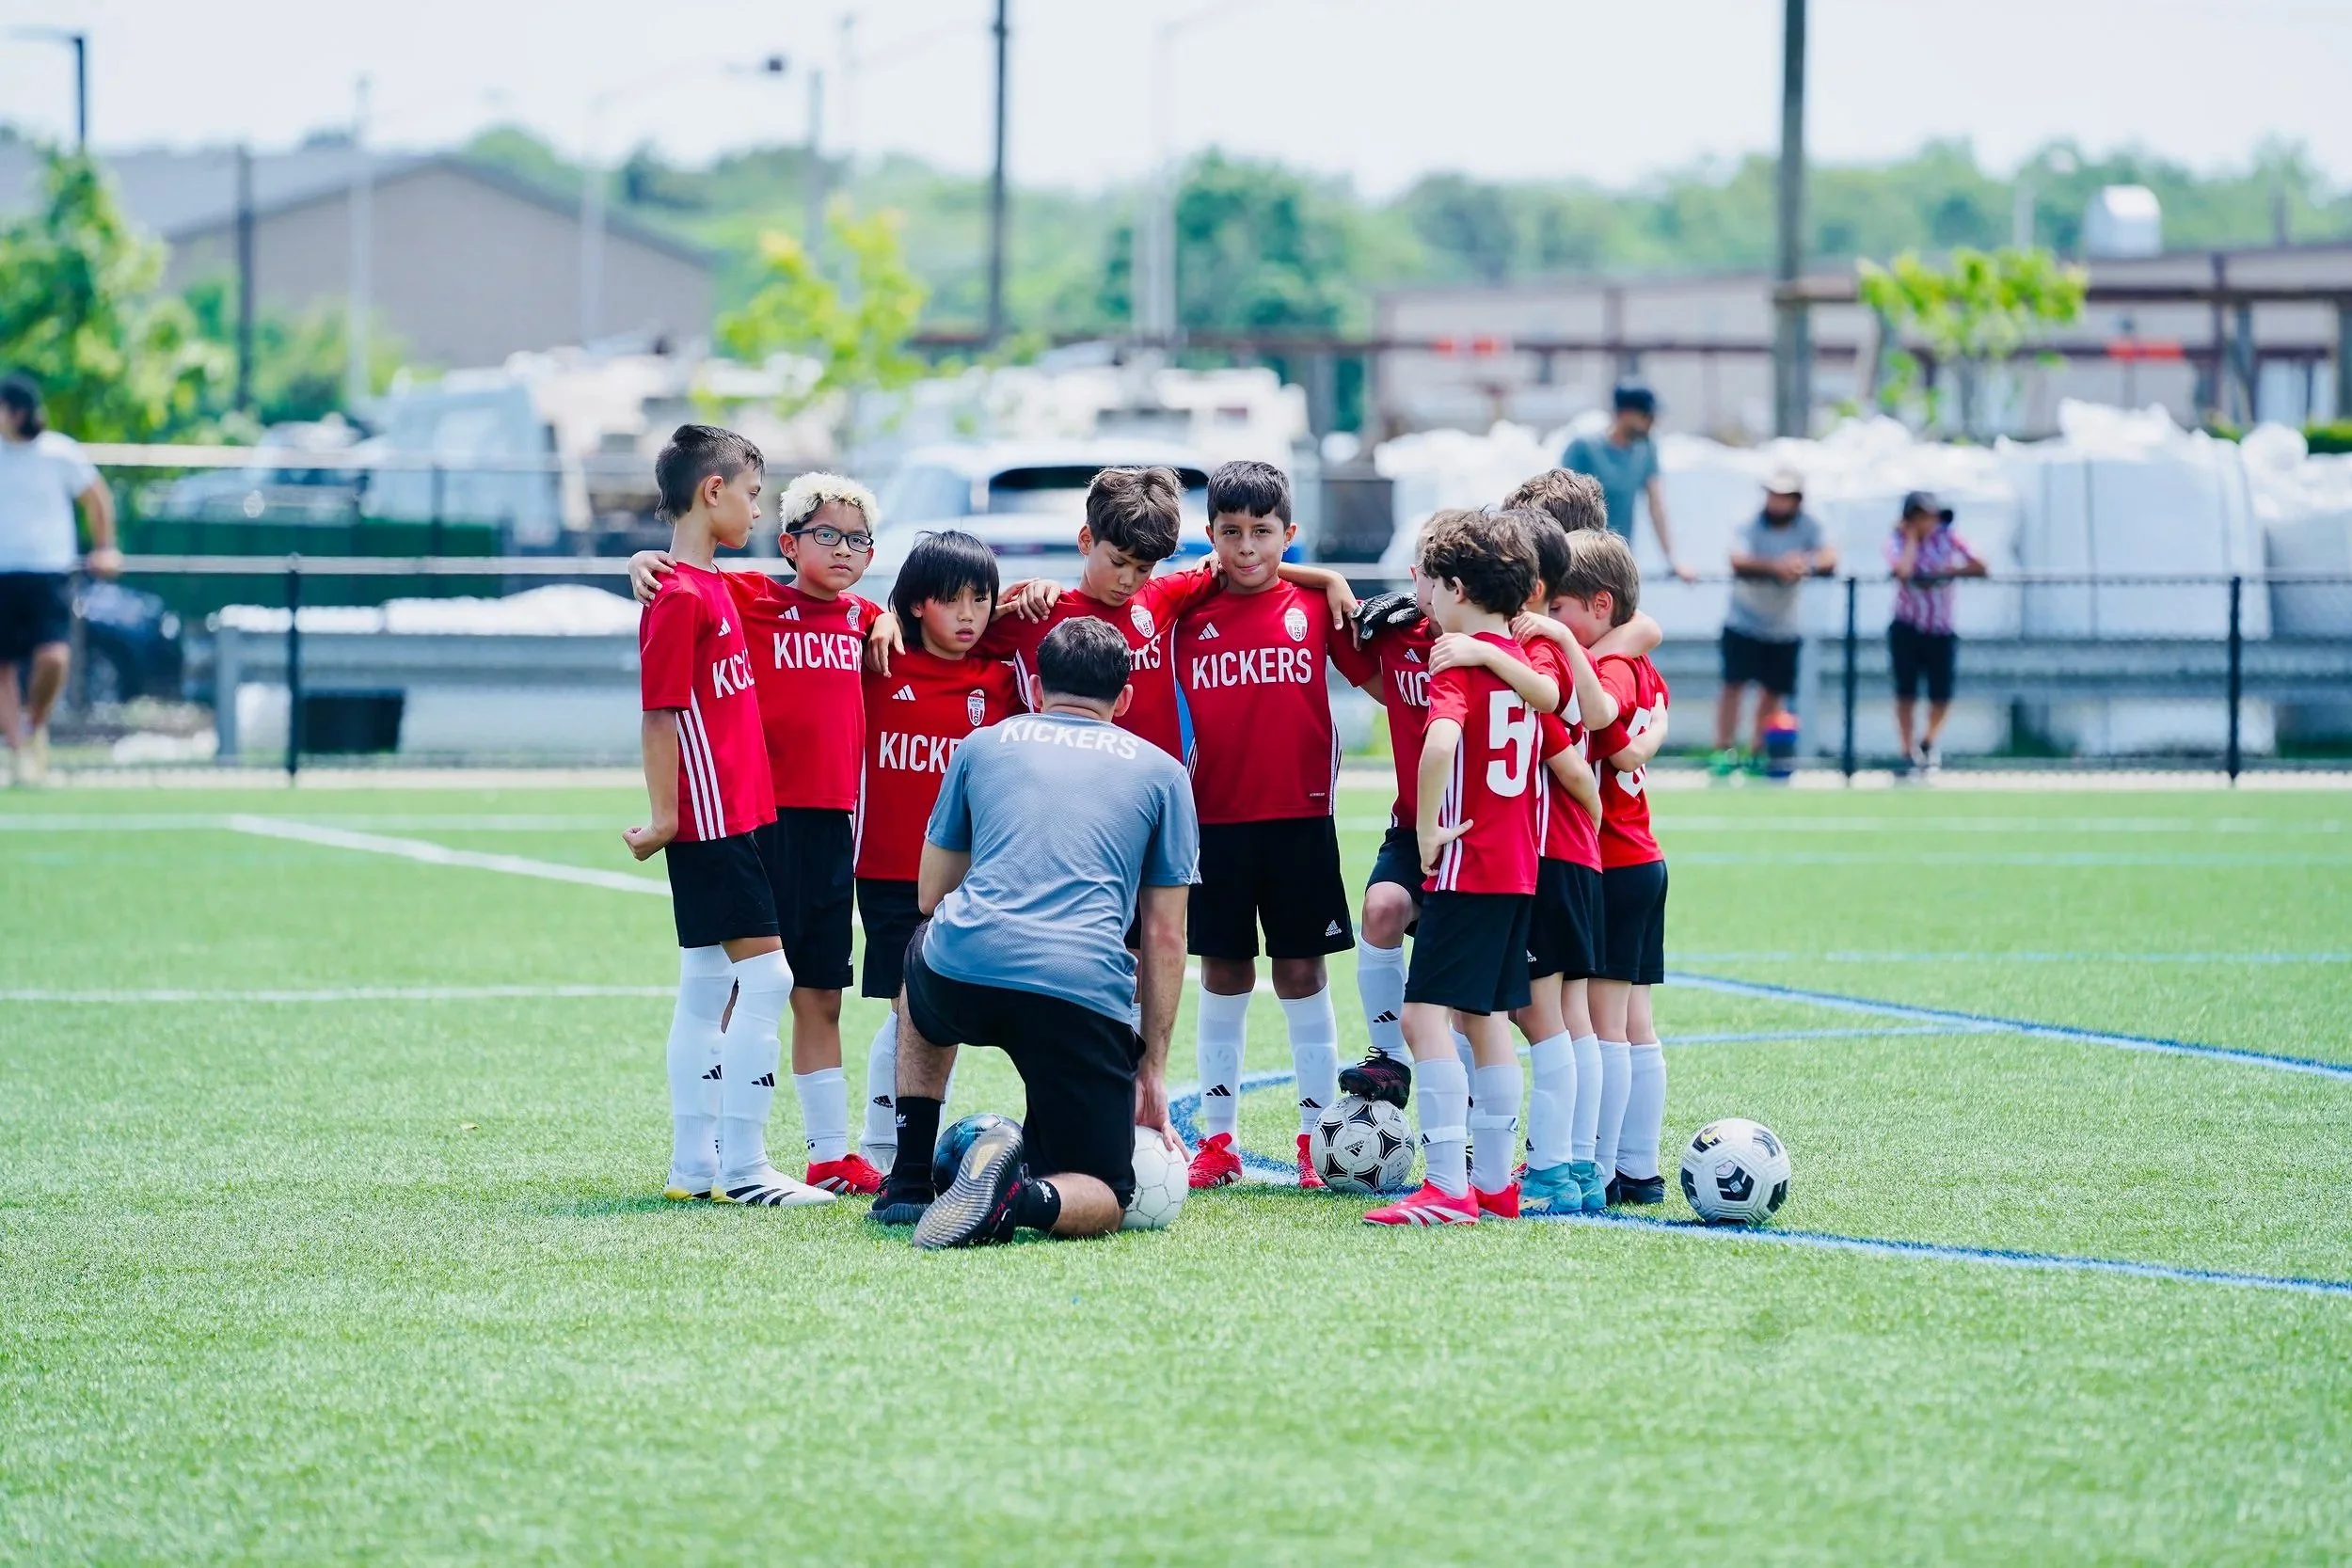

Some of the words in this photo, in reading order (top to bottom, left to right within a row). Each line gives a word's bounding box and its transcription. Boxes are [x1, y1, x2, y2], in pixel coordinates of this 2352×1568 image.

[773, 632, 862, 673] KICKER
[1192, 647, 1312, 689] KICKERS
[999, 720, 1139, 760] KICKERS
